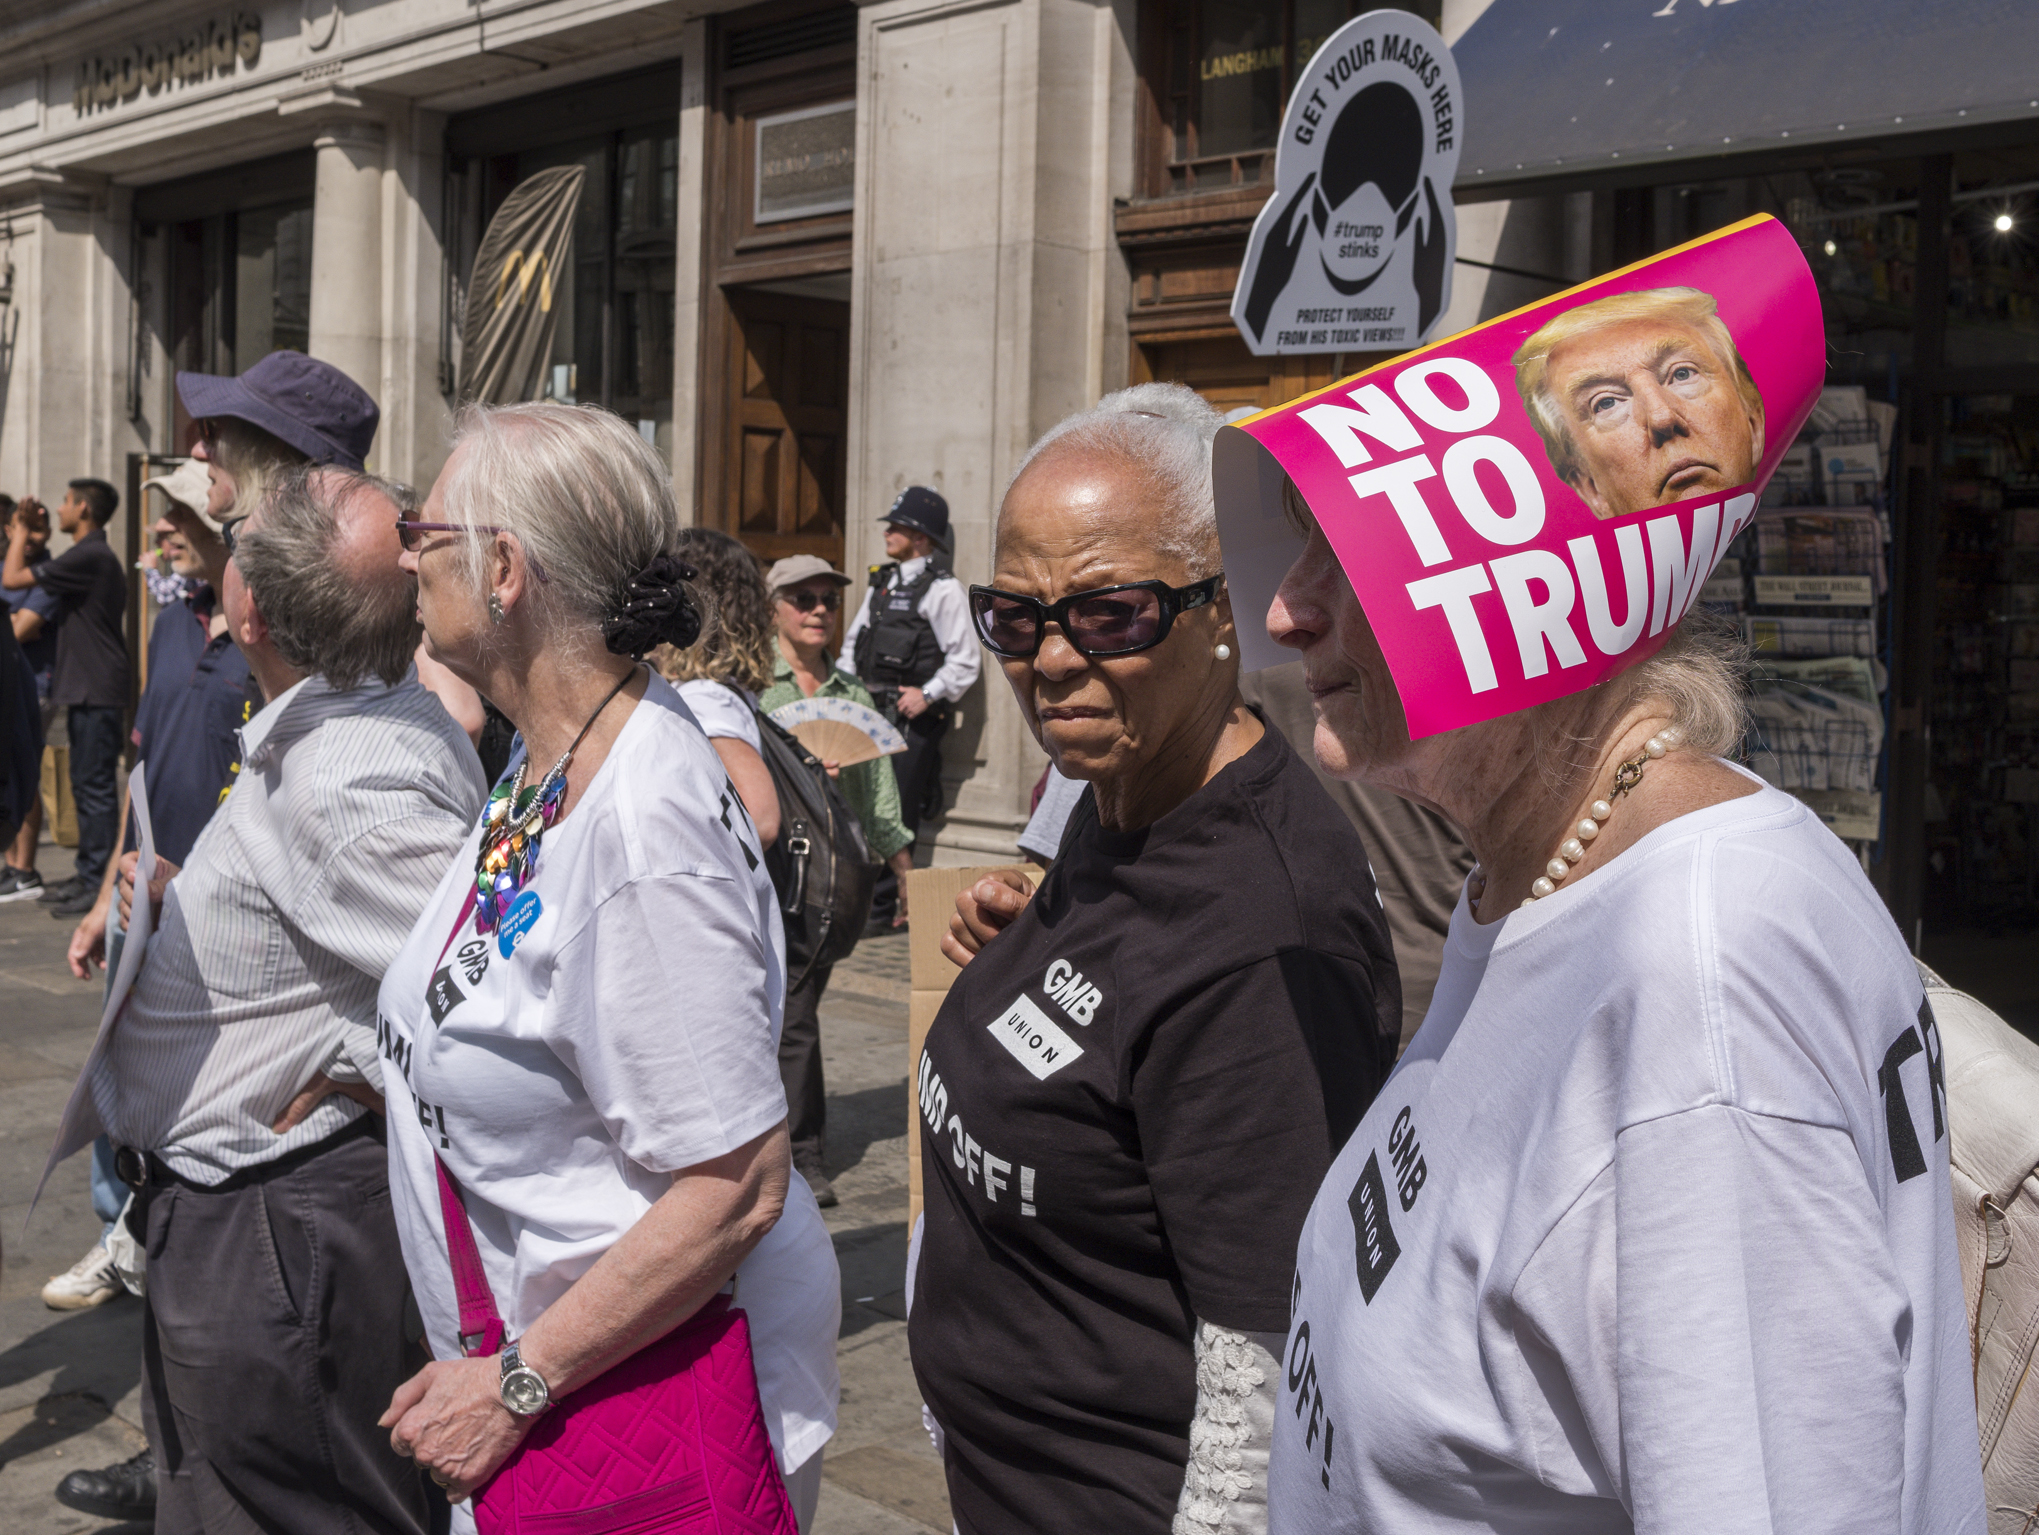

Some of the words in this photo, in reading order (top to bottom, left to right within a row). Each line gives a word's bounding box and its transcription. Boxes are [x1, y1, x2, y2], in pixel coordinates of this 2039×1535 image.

[73, 11, 262, 114] McDonald's
[1201, 45, 1284, 80] LANGHAM
[1295, 88, 1328, 146] GET
[1324, 38, 1376, 91] YOUR
[1381, 34, 1441, 89] MASKS
[1430, 84, 1453, 154] HERE
[1334, 221, 1384, 242] #trump
[1338, 241, 1380, 259] stinks
[1277, 330, 1308, 345] FROM
[1310, 329, 1328, 344] HIS
[1331, 328, 1361, 343] TOXIC
[1363, 327, 1406, 342] VIEWS!!!
[1296, 308, 1344, 324] PROTECT
[1346, 307, 1396, 322] YOURSELF
[1296, 357, 1500, 469] NO
[1347, 434, 1546, 567] TO
[1405, 492, 1757, 695] TRUMP
[500, 911, 520, 933] Please
[519, 897, 537, 915] offer
[503, 926, 514, 938] me
[518, 909, 533, 925] seat
[457, 940, 489, 986] GMB
[1043, 959, 1102, 1027] GMB
[1007, 1012, 1059, 1064] UNION
[948, 1114, 1037, 1217] OFF!
[1388, 1105, 1428, 1213] GMB
[1361, 1182, 1382, 1269] UNION
[1288, 1320, 1334, 1492] OFF!
